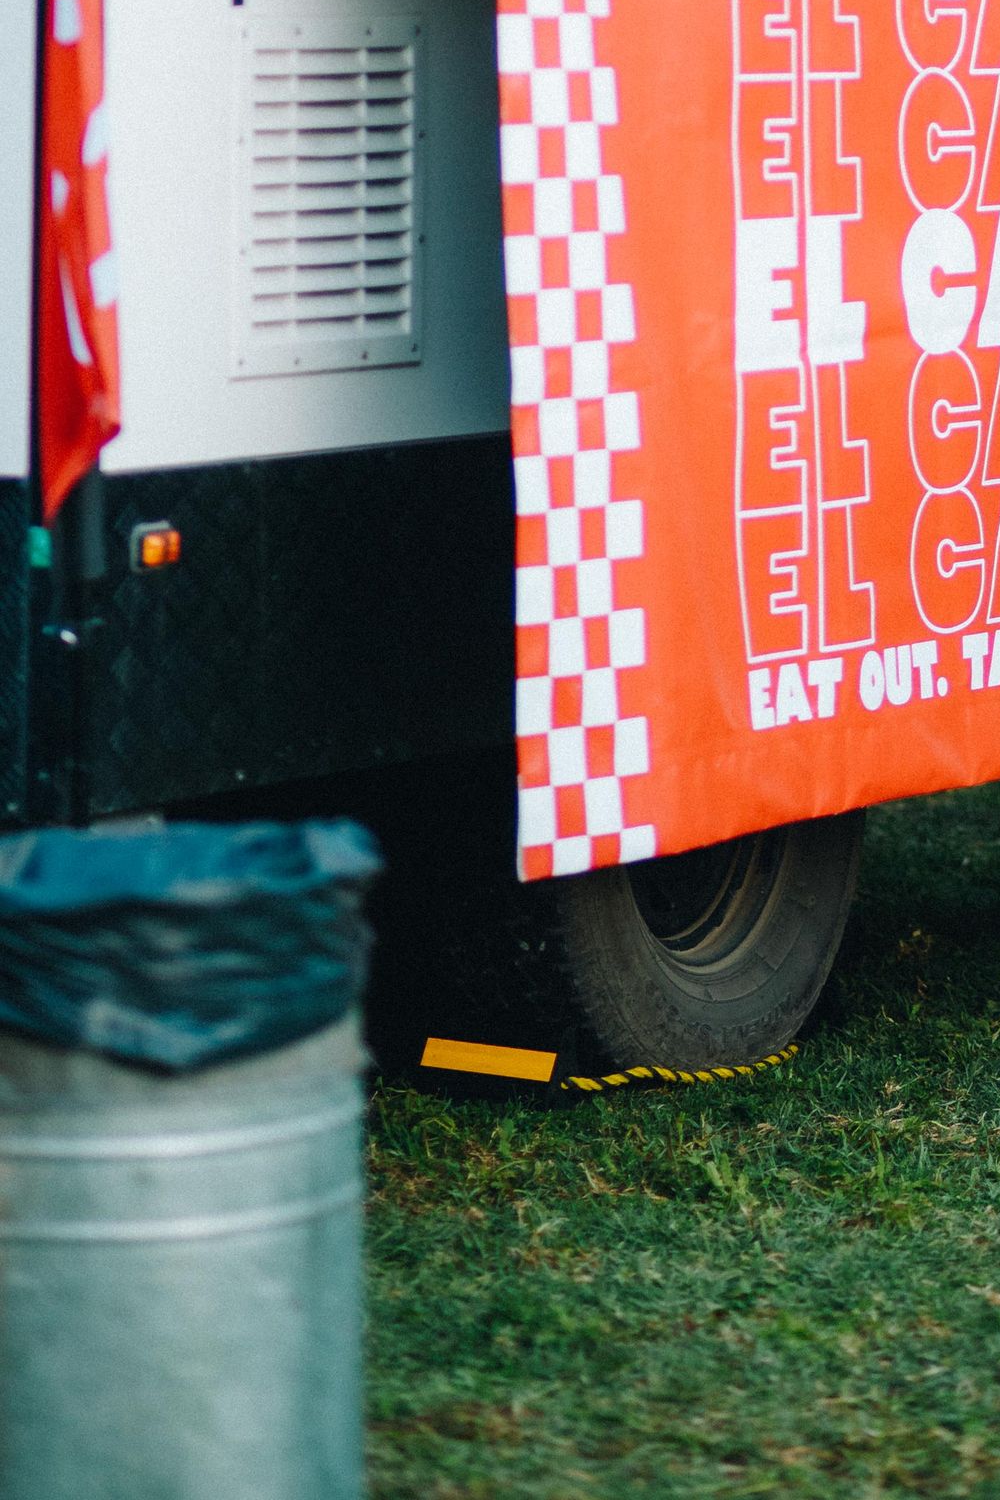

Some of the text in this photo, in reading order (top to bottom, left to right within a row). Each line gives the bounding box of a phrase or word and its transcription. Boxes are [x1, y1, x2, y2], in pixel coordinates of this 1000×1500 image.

[733, 74, 864, 221] EL
[735, 215, 867, 373] EL
[735, 363, 870, 512] EL
[736, 502, 876, 663] EL
[748, 650, 844, 731] EAT
[859, 636, 948, 711] OUT.
